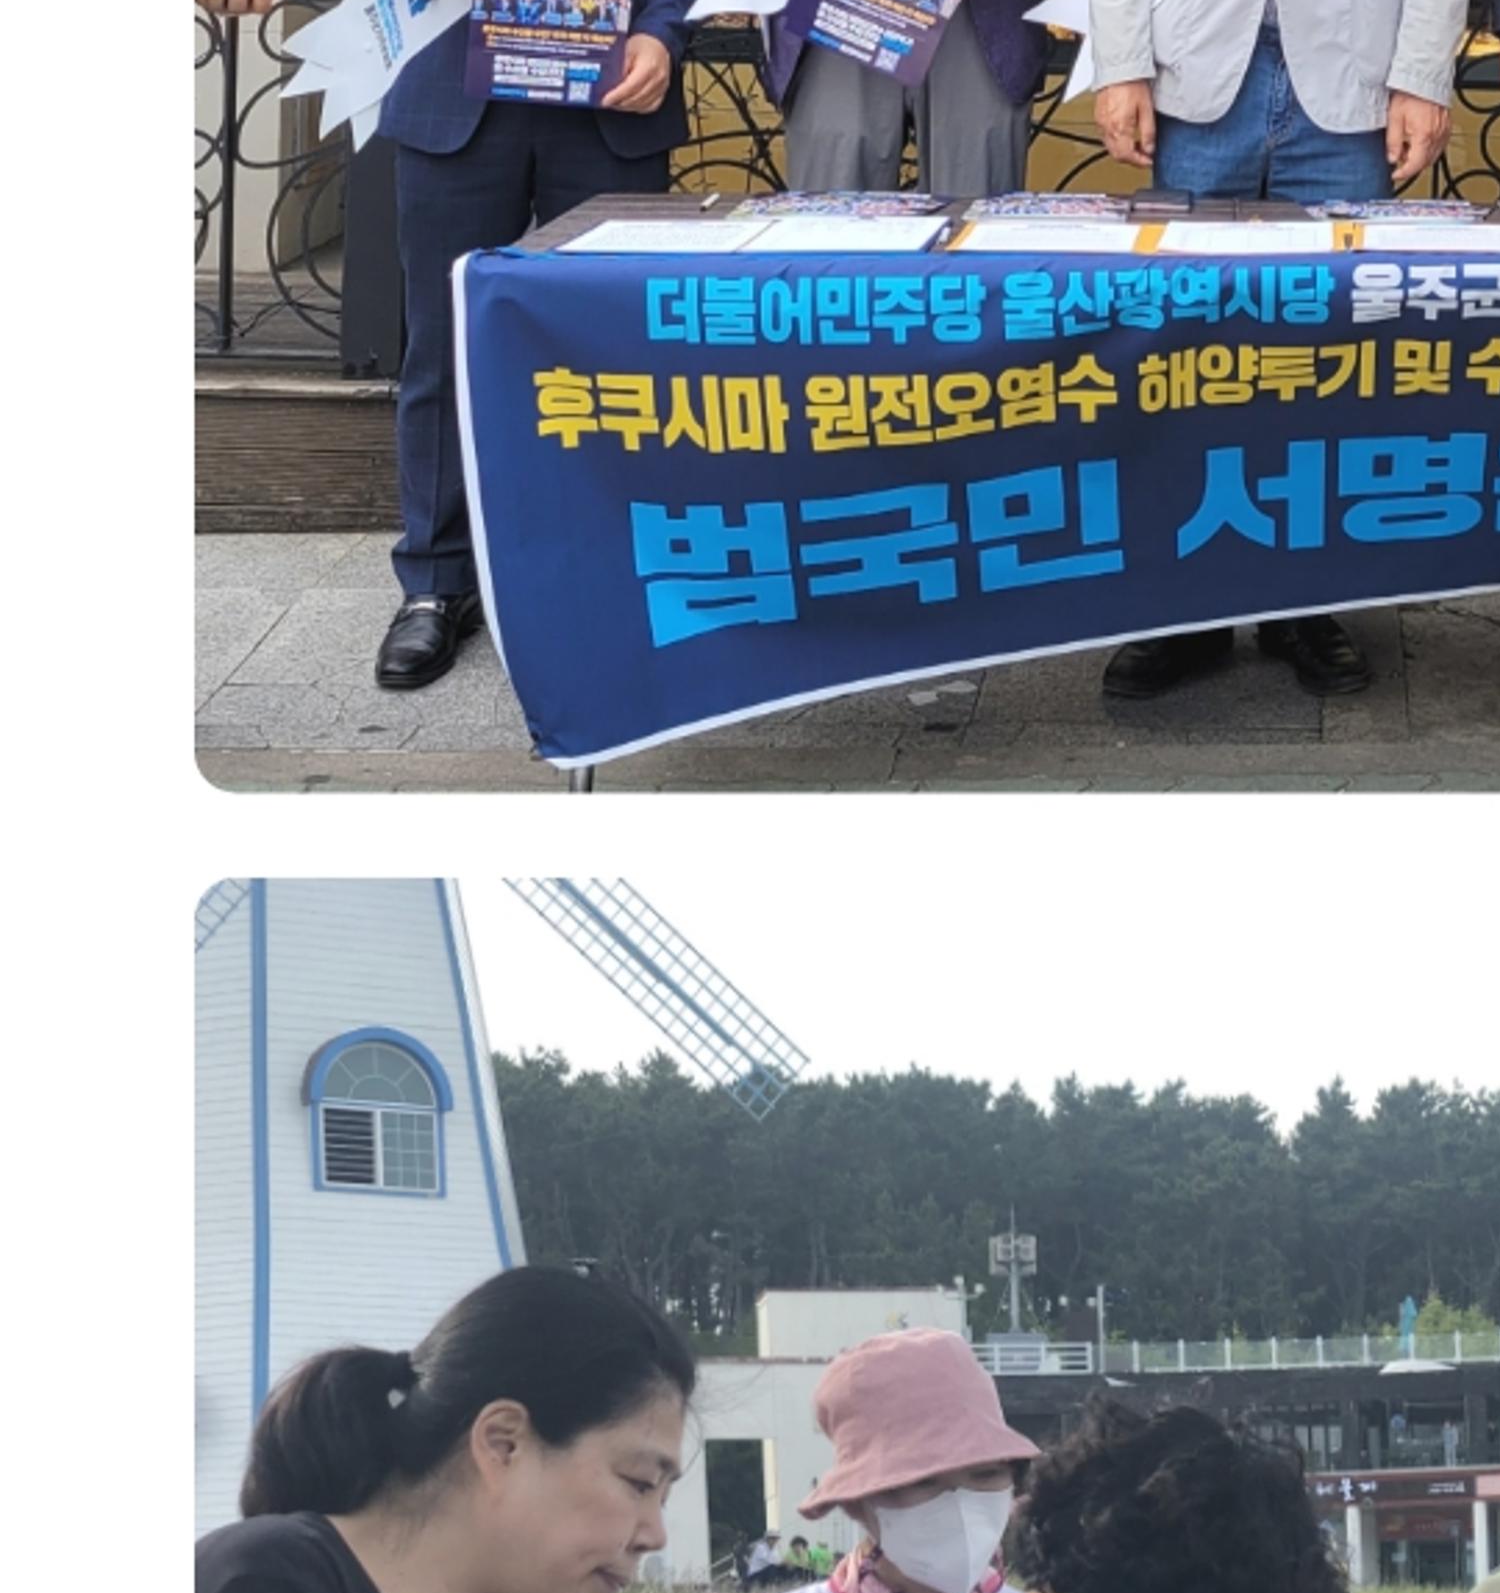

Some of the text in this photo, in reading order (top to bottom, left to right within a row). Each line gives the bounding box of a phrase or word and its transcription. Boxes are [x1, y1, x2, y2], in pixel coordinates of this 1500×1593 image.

[646, 271, 988, 345] 더불어민주당
[1000, 264, 1337, 339] 울산광역시당
[533, 367, 788, 452] 후쿠시마
[806, 354, 1117, 451] 원전오염수
[1139, 340, 1376, 412] 해양투기
[1395, 340, 1450, 394] 및
[630, 458, 1125, 648] 범국민
